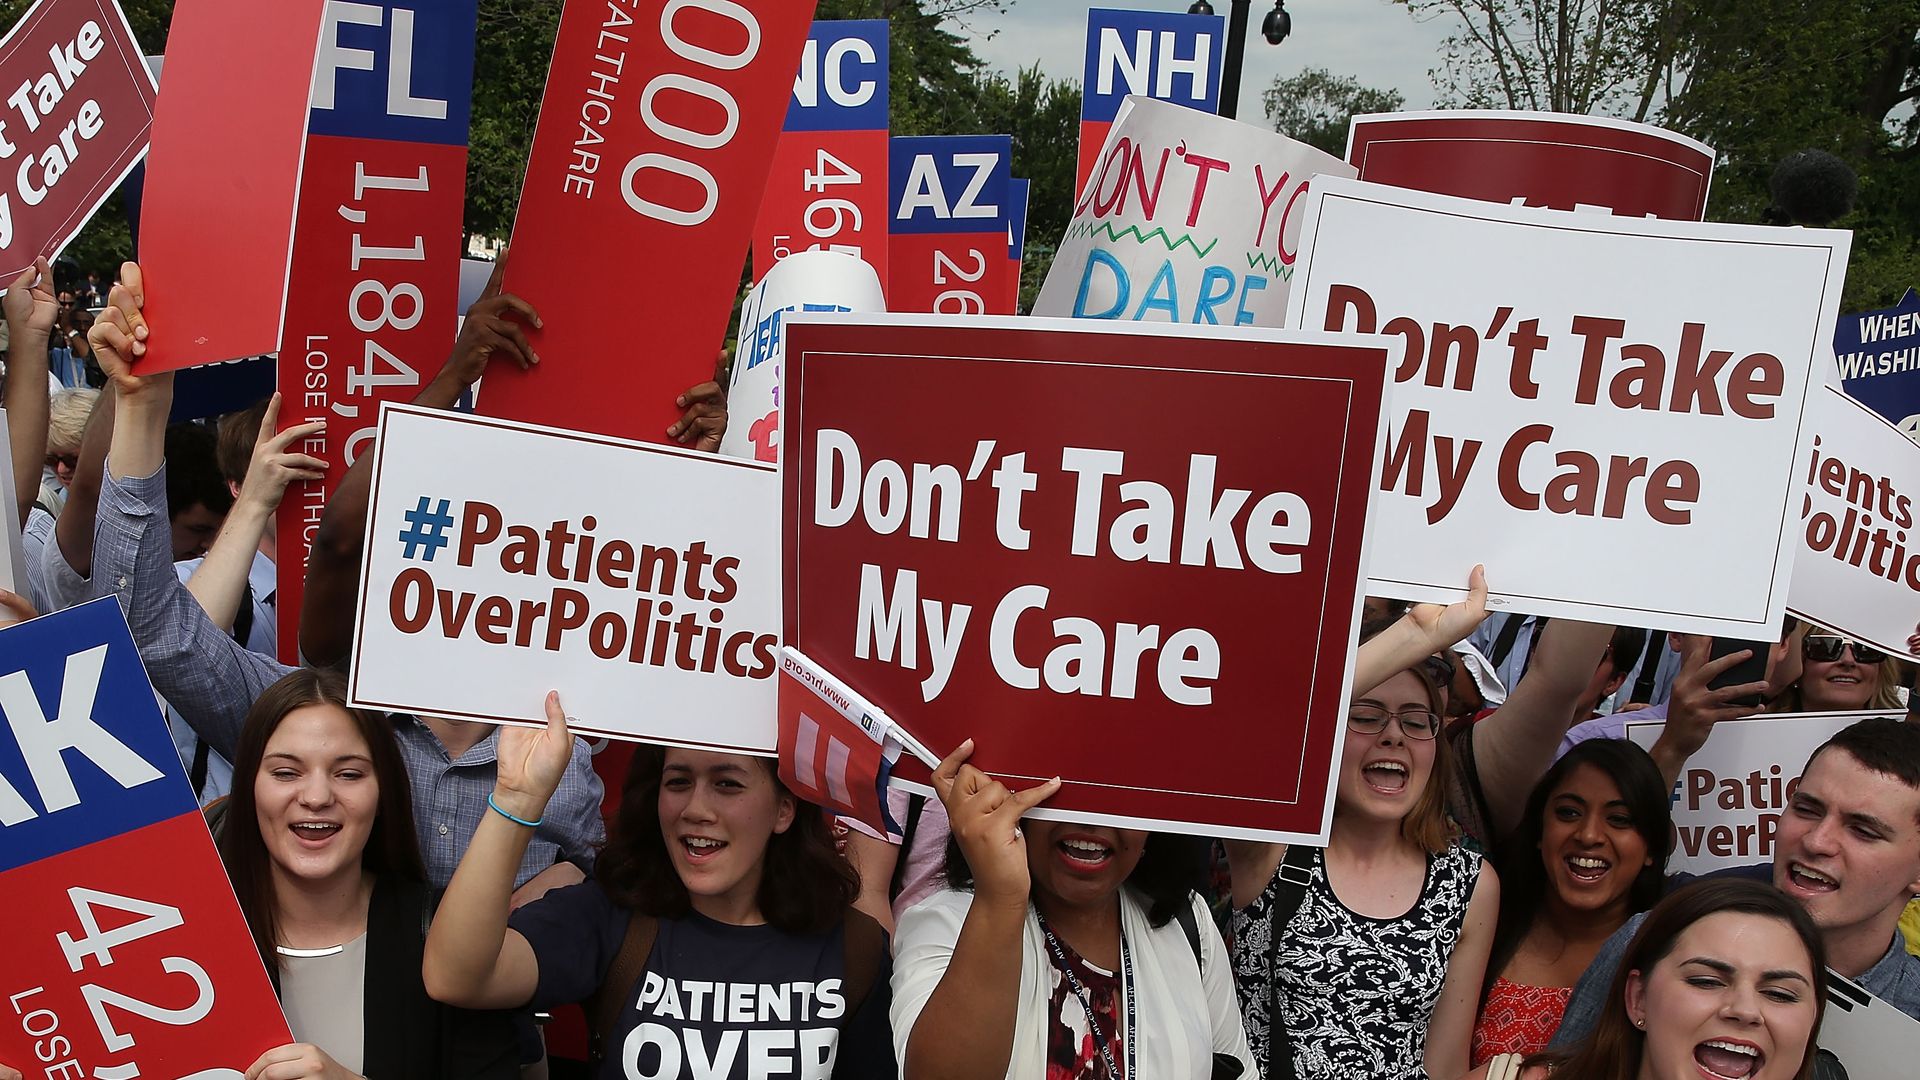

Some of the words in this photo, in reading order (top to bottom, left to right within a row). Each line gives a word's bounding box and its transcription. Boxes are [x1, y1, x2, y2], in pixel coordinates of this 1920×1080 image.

[7, 20, 105, 133] Take
[311, 0, 447, 119] FL
[563, 0, 638, 199] ALTHCARE
[1096, 27, 1211, 100] NH
[16, 99, 104, 206] Care
[896, 153, 999, 219] AZ
[305, 336, 329, 407] LOSE
[1571, 315, 1785, 420] Take
[814, 428, 1038, 551] Don't
[1061, 447, 1312, 574] Take
[1379, 408, 1484, 526] My
[1497, 423, 1701, 526] Care
[398, 496, 740, 604] #Patients
[389, 567, 778, 680] OverPolitics
[855, 563, 972, 703] My
[989, 585, 1221, 705] Care
[55, 886, 245, 1080] 42,
[1046, 931, 1066, 960] AFL-CIO
[1066, 969, 1085, 998] AFL-CIO
[9, 986, 85, 1080] LOSE
[635, 971, 846, 1023] PATIENTS
[1085, 1007, 1102, 1036] AFL-CIO
[1127, 985, 1136, 1015] AFL-CIO
[622, 1022, 840, 1080] OVER
[1102, 1045, 1120, 1076] AFL-CIO
